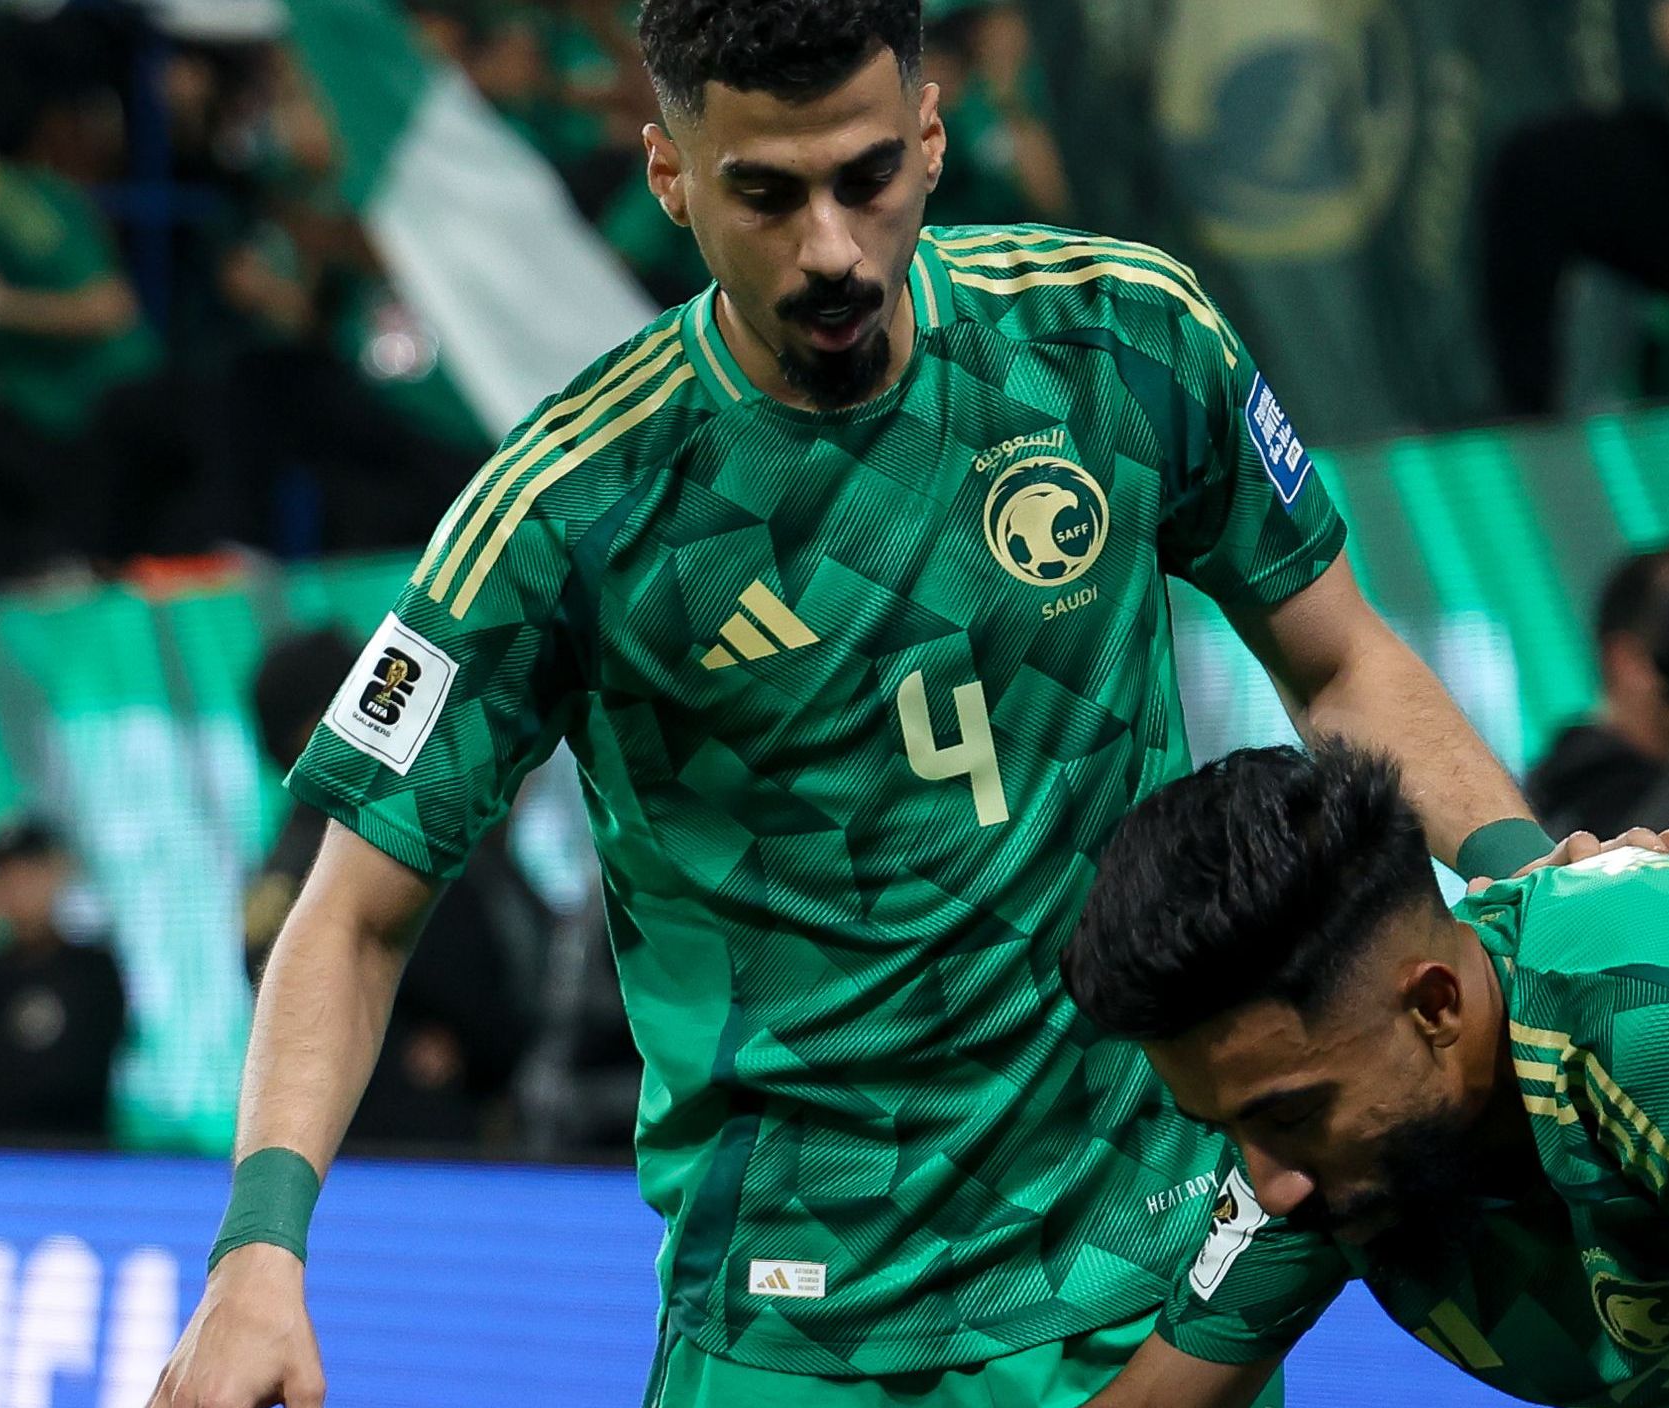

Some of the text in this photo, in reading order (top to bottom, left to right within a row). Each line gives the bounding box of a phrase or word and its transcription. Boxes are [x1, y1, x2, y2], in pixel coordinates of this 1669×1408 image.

[1055, 522, 1090, 544] SAFF
[1041, 585, 1098, 621] SAUDI
[352, 711, 392, 738] QUALIFIERS
[366, 701, 389, 719] FIFA
[897, 669, 1010, 827] 4
[1145, 1170, 1220, 1216] HEAT.RDY
